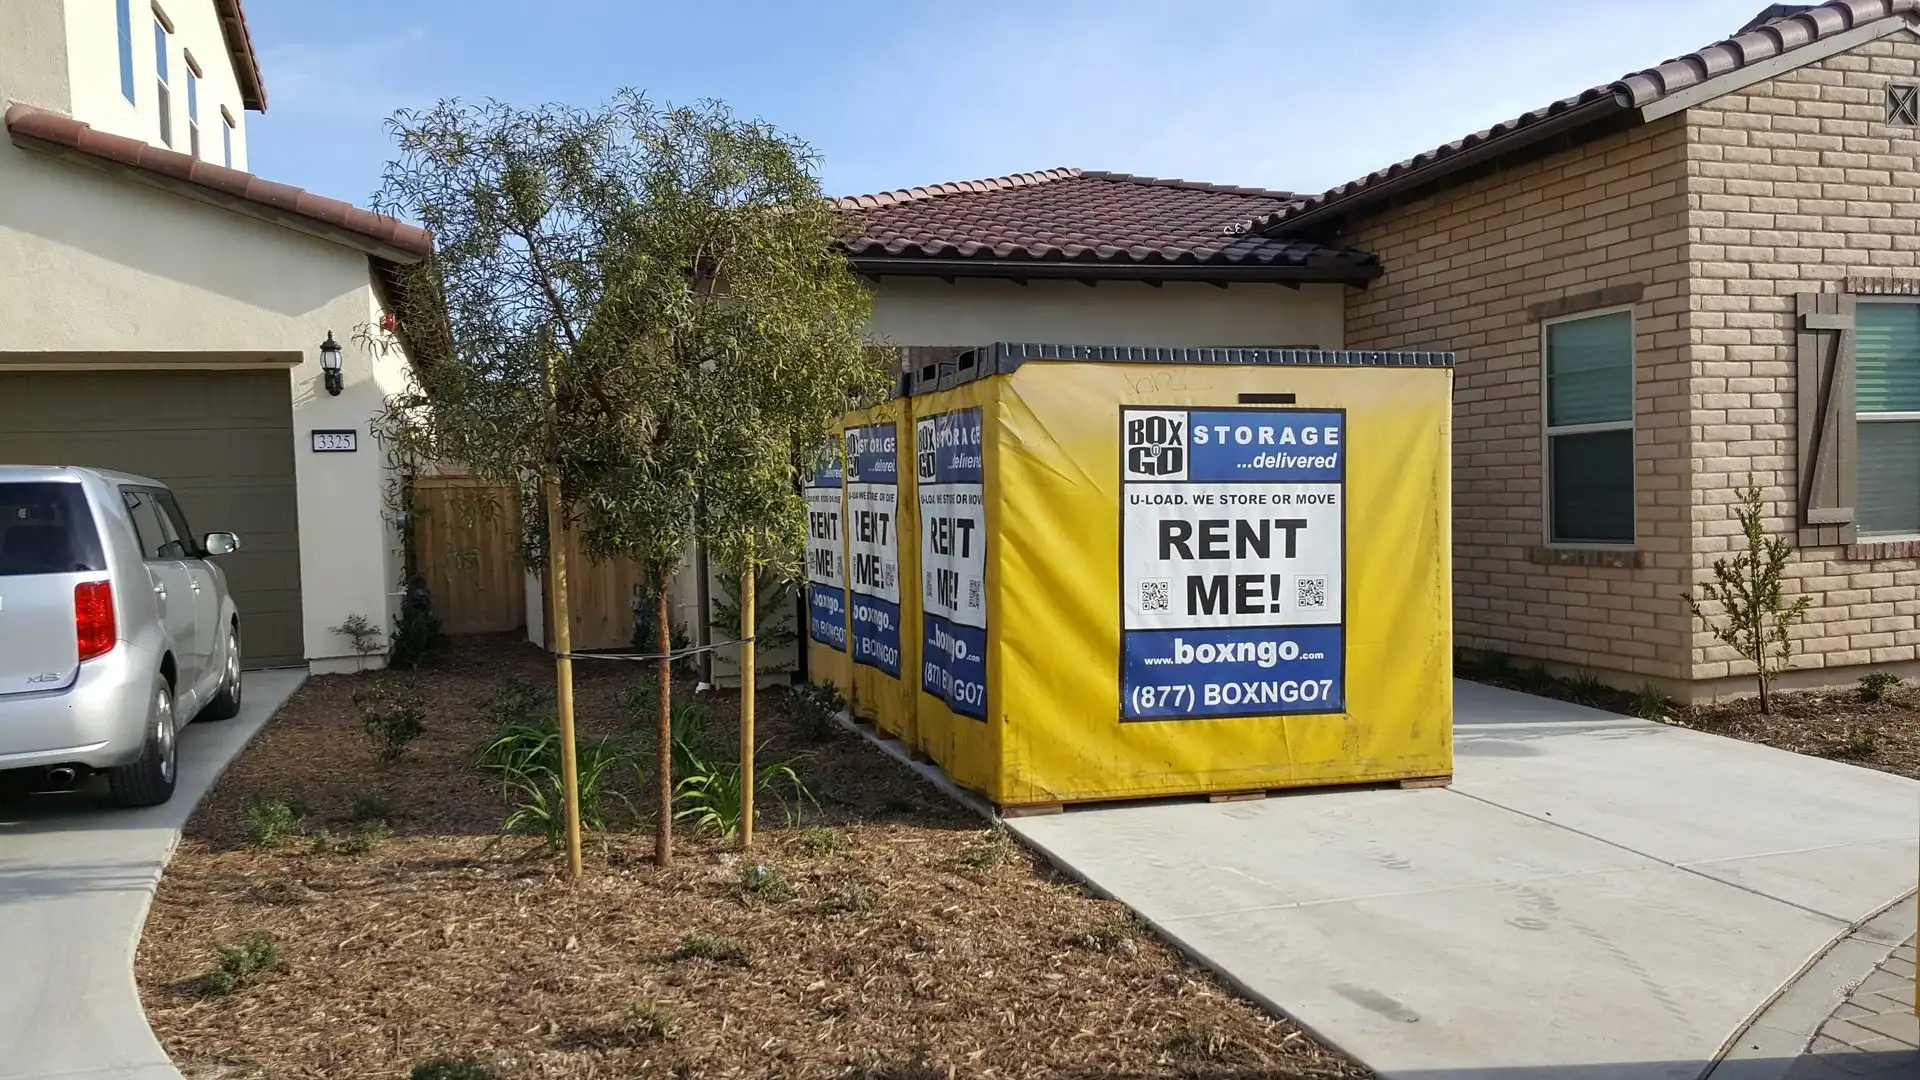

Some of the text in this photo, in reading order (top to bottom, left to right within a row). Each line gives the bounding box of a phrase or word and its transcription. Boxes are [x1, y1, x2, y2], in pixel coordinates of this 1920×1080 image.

[319, 435, 351, 449] 3325
[936, 426, 981, 448] STORAGE
[1128, 416, 1183, 446] BOX
[1193, 426, 1339, 446] STORAGE
[1128, 447, 1183, 476] GO
[1236, 452, 1338, 469] ...delivered
[956, 494, 968, 505] OR
[969, 494, 983, 505] MOV
[1130, 494, 1336, 505] U-LOAD. WE STORE OR MOVE
[930, 516, 975, 558] RENT
[1158, 518, 1308, 560] RENT
[815, 548, 834, 578] ME!
[856, 553, 885, 589] ME!
[937, 568, 959, 611] ME!
[1186, 573, 1281, 616] ME!
[1144, 638, 1324, 668] www.boxngo.com
[942, 669, 984, 706] BGO7
[1132, 680, 1333, 714] (877) BOXNGO7
